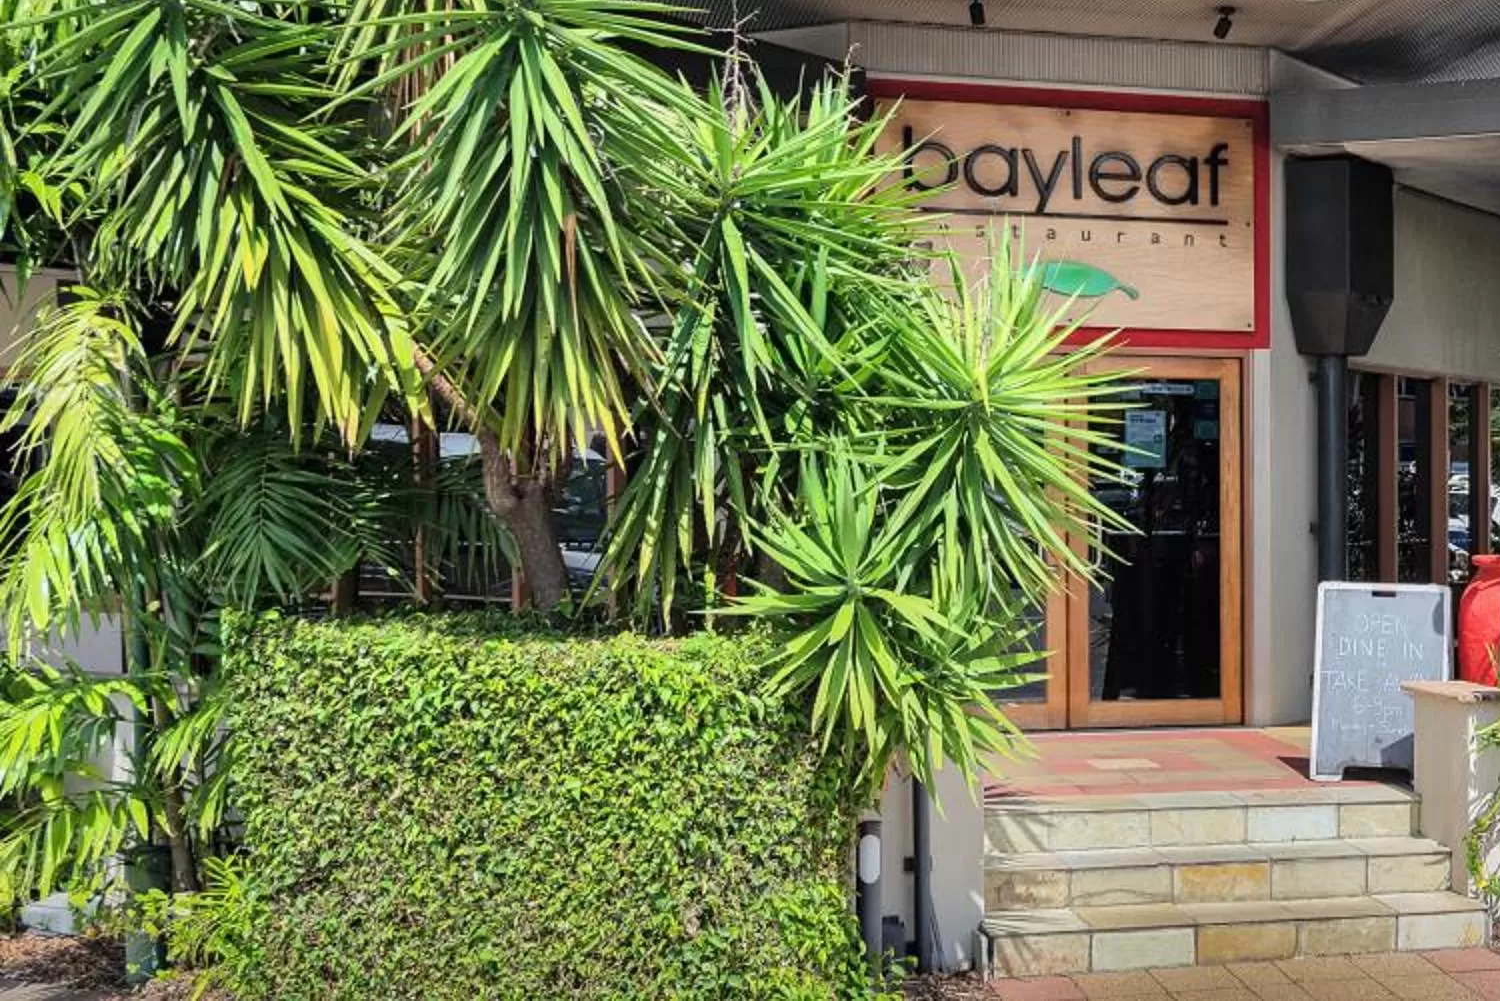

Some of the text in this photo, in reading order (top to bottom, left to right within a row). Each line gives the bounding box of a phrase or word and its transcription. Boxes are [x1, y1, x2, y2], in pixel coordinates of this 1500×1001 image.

[902, 125, 1229, 215] bayleaf
[1355, 613, 1409, 636] OPEN
[1338, 636, 1425, 660] DINE IN
